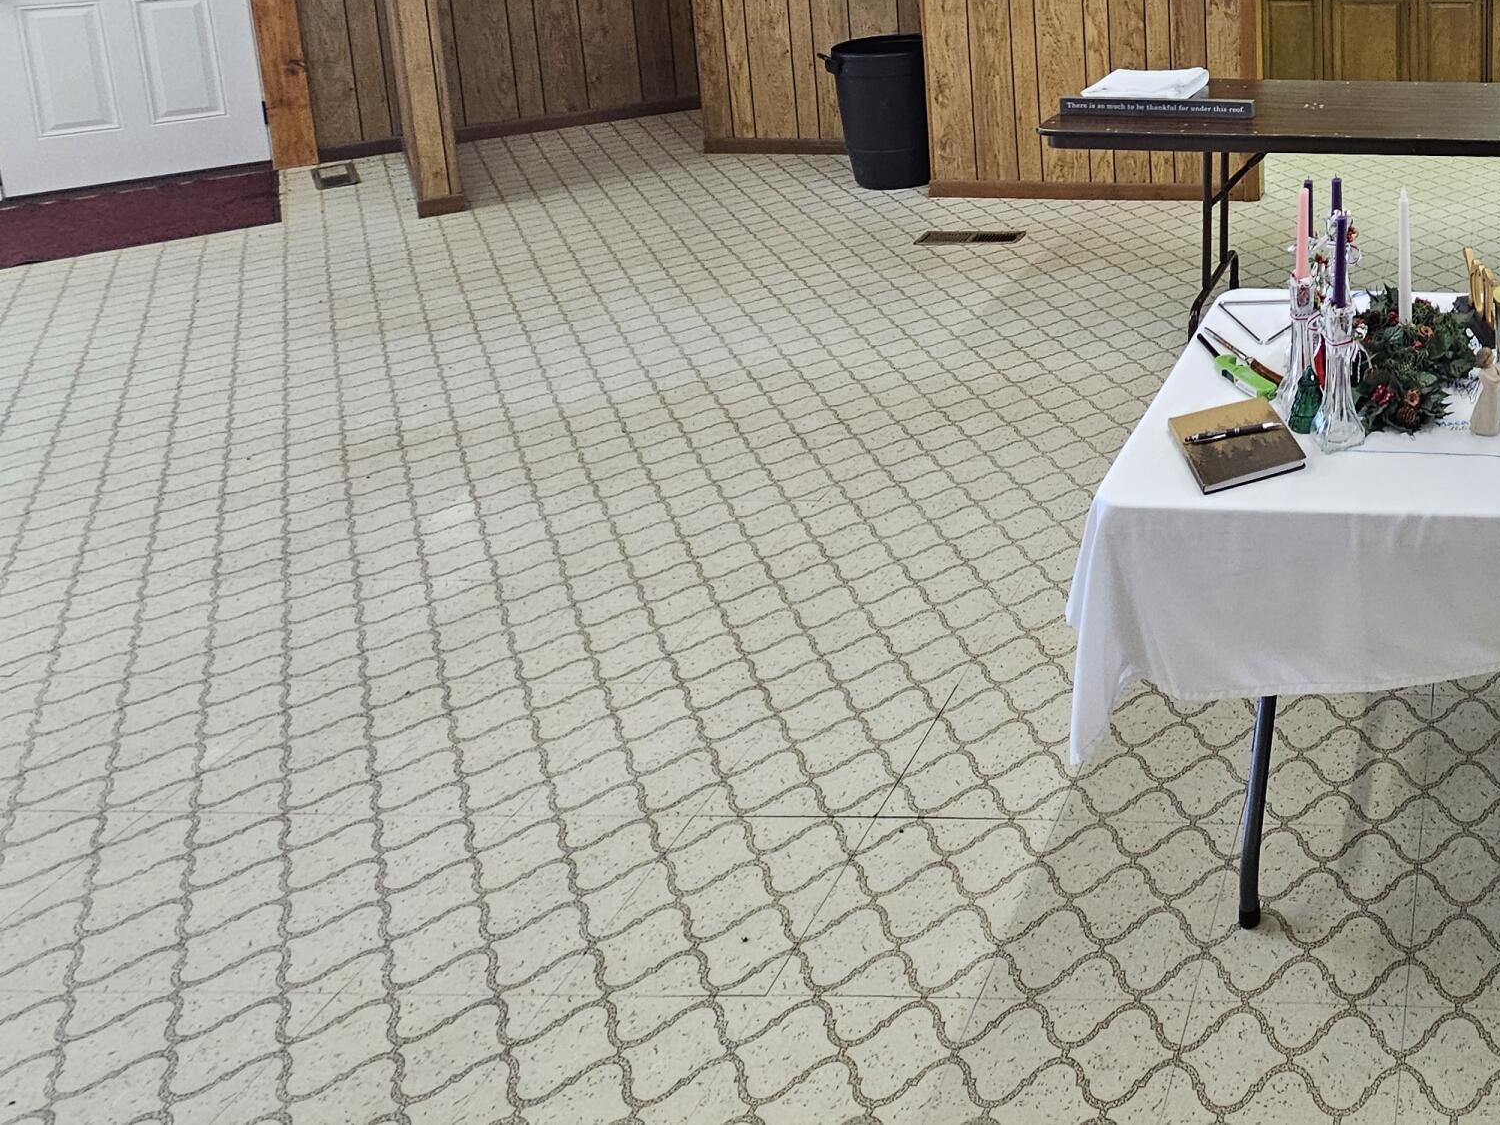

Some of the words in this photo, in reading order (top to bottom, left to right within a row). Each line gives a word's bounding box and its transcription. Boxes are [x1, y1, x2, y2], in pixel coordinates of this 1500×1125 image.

[1066, 101, 1088, 110] There
[1088, 102, 1096, 110] is
[1106, 102, 1126, 111] much
[1127, 103, 1135, 111] to
[1136, 103, 1145, 112] be
[1146, 103, 1177, 112] thankful
[1178, 104, 1189, 112] for
[1190, 104, 1212, 113] under
[1213, 104, 1228, 113] this
